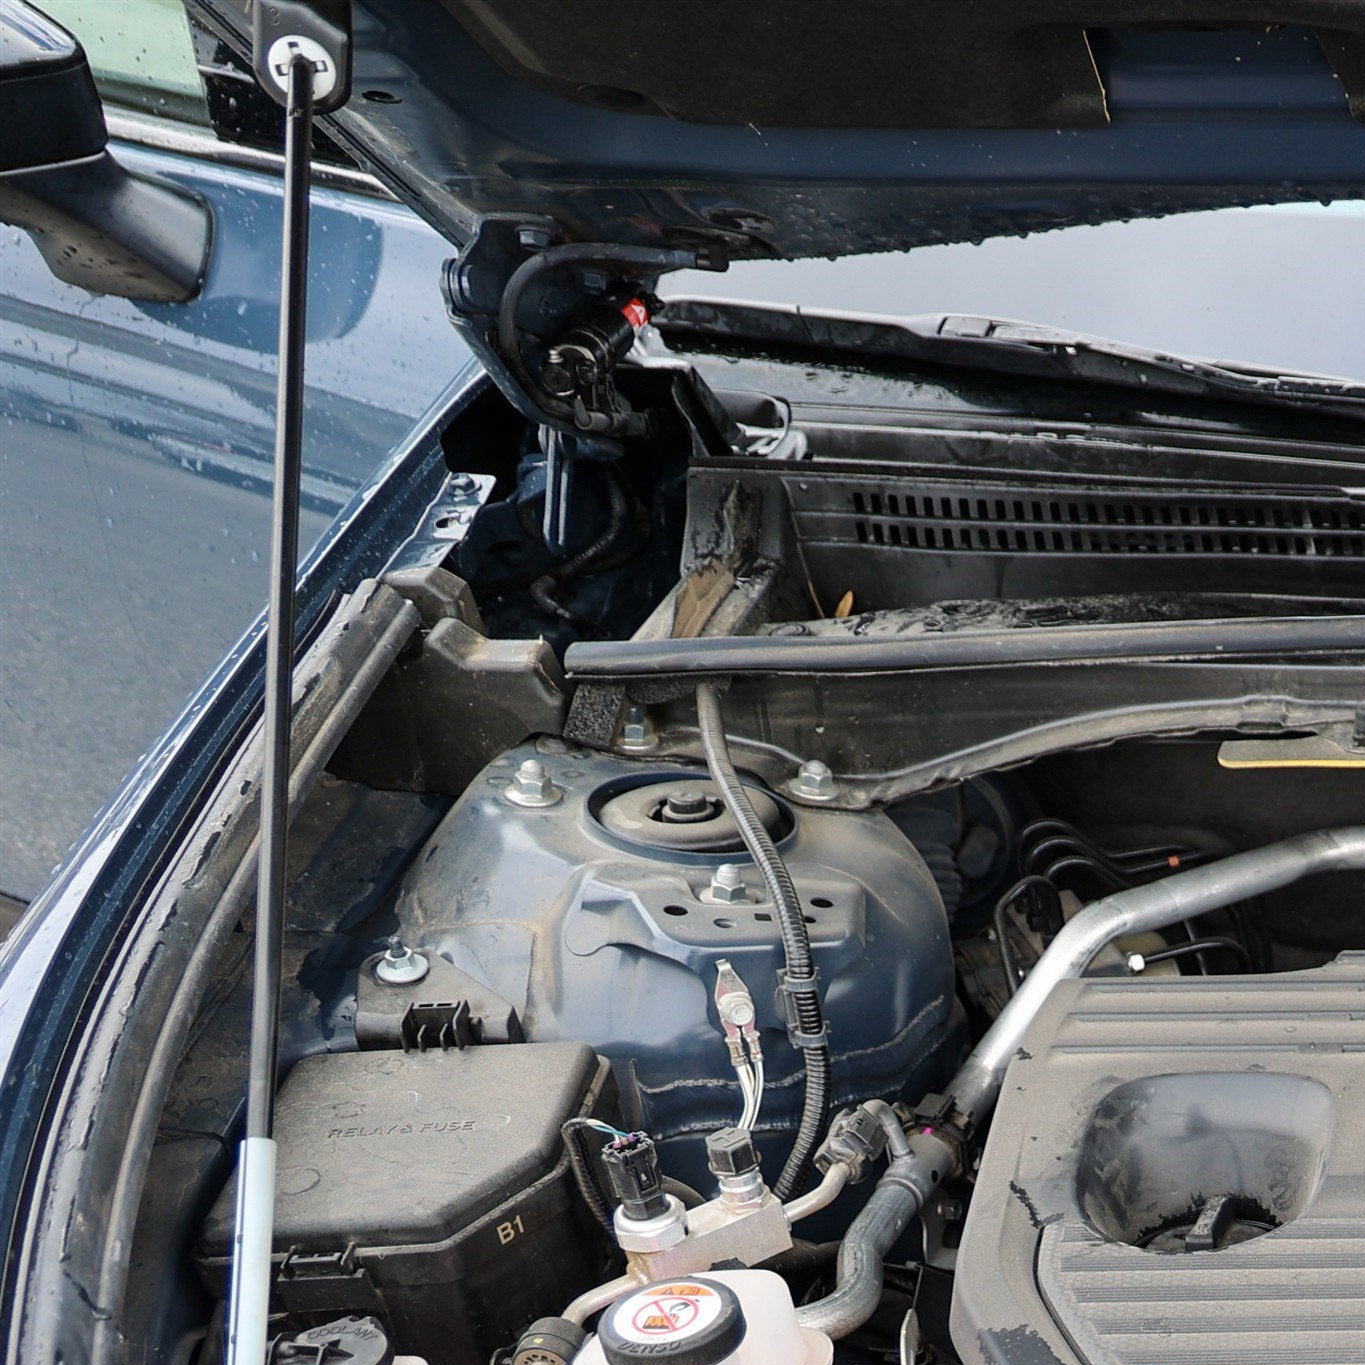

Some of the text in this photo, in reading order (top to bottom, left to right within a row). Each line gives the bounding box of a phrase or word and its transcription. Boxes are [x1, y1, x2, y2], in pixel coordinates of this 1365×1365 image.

[327, 1120, 476, 1139] RELAY & FUSE
[496, 1214, 526, 1246] B1
[307, 1325, 380, 1341] COOLANT
[617, 1340, 682, 1355] DENSO
